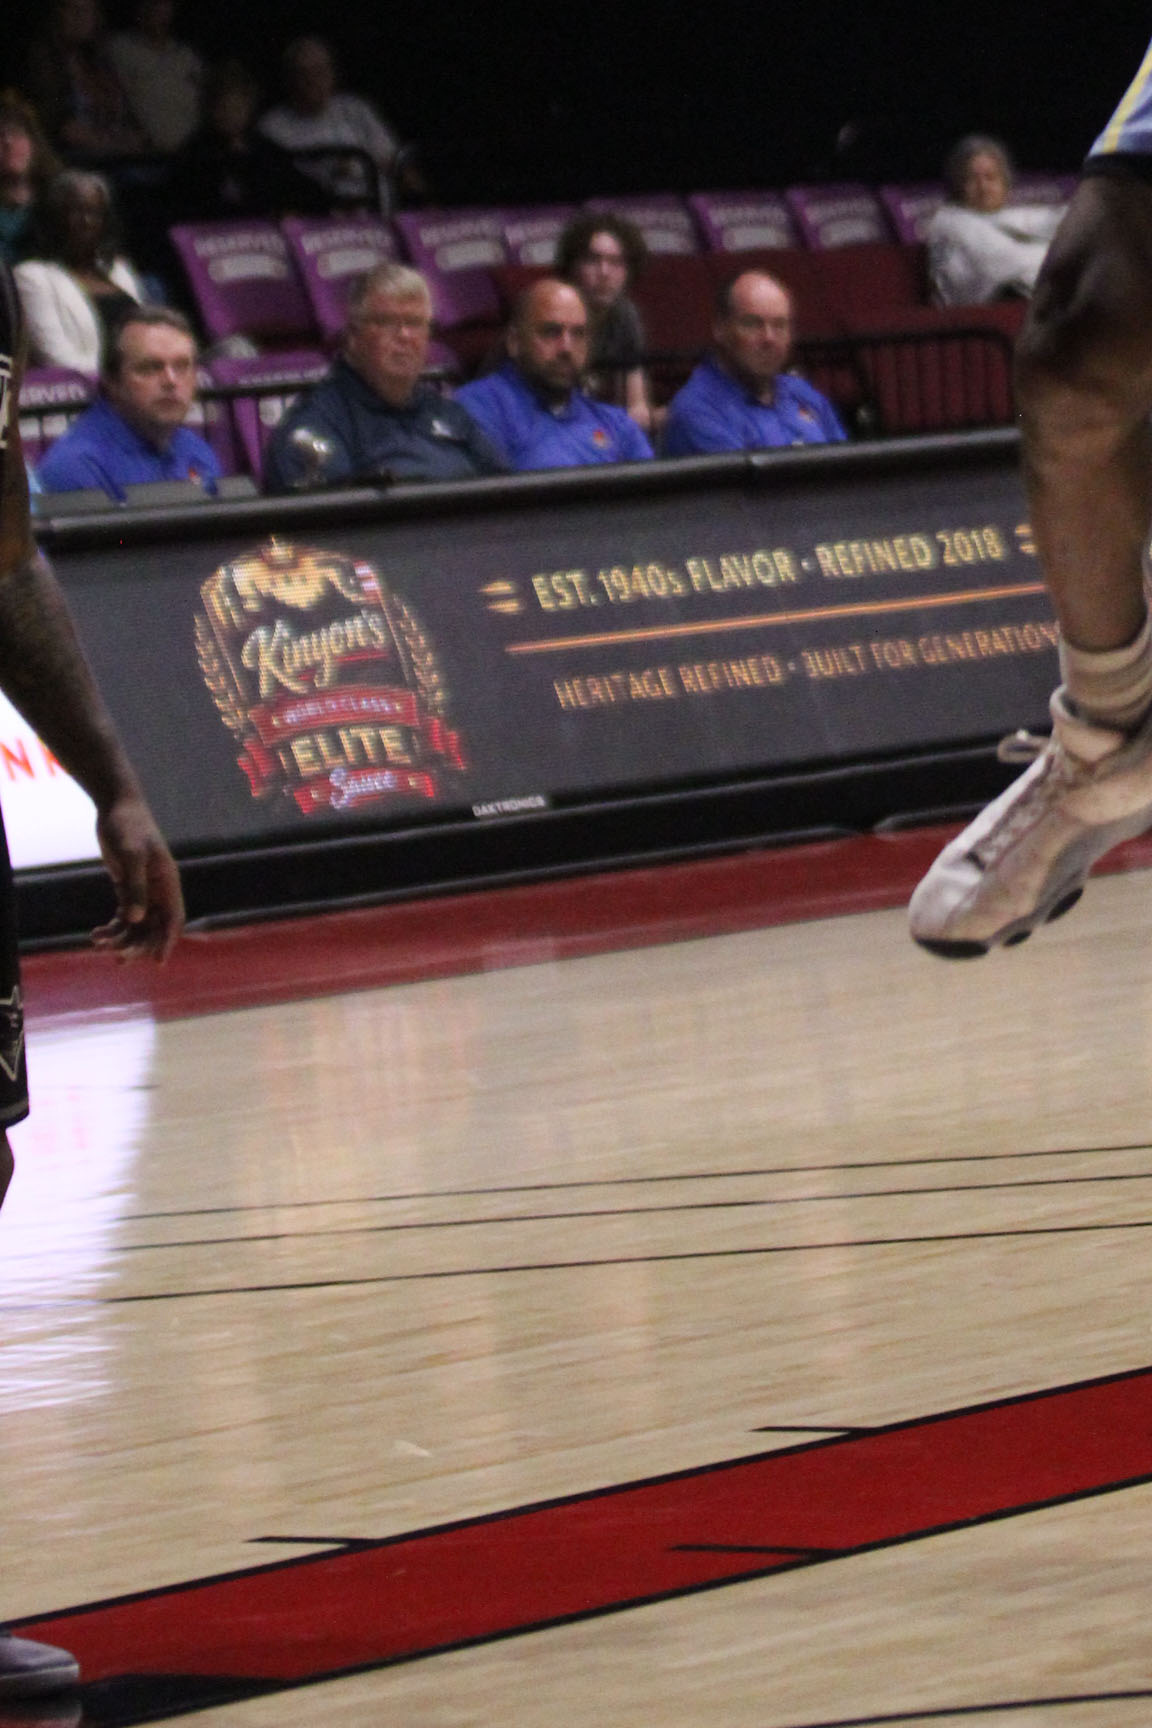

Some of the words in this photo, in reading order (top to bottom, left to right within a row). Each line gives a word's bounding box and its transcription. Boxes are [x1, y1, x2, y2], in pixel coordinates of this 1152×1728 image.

[532, 568, 599, 612] EST.
[597, 561, 688, 605] 1940s
[686, 547, 797, 593] FLAVOR
[814, 532, 937, 578] REFINED
[936, 524, 1007, 567] 2018
[553, 669, 674, 711] HERITAGE
[678, 655, 785, 696] REFINED
[801, 644, 866, 679] BUILT
[869, 639, 918, 670] FOR
[918, 619, 1060, 665] GENERATION
[289, 727, 412, 777] ELITE
[471, 794, 546, 818] DAKTRONICS
